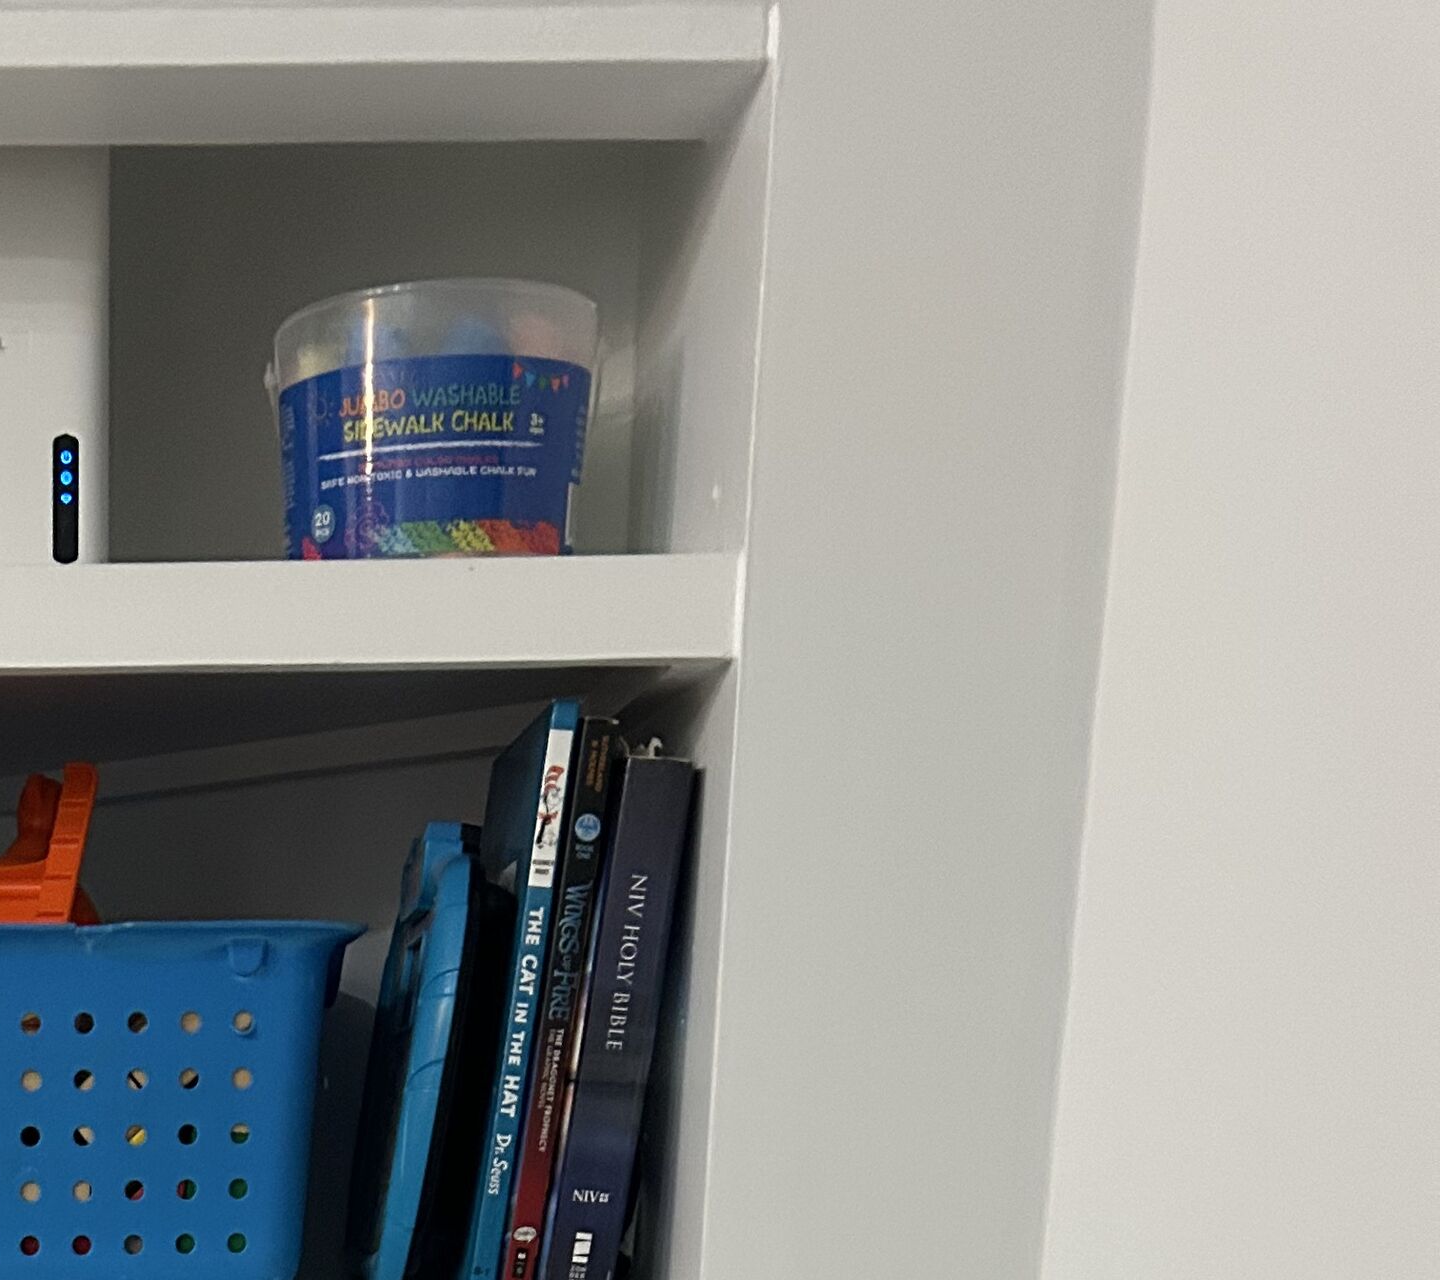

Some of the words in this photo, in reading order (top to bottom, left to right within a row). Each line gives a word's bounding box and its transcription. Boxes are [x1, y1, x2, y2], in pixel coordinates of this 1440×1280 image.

[412, 383, 522, 409] WASHABLE
[343, 412, 445, 443] SIDEWALK
[451, 410, 514, 433] CHALK
[415, 465, 477, 478] WASHABLE
[479, 465, 514, 476] CHALK
[315, 511, 330, 527] 20
[627, 875, 648, 918] NIV
[525, 907, 544, 945] THE
[559, 882, 591, 953] WINGS
[616, 924, 641, 985] HOLY
[519, 955, 538, 995] CAT
[548, 969, 580, 1020] FIRE
[515, 1003, 529, 1024] IN
[605, 992, 631, 1051] BIBLE
[508, 1031, 526, 1066] THE
[554, 1028, 564, 1047] THE
[500, 1075, 521, 1118] HAT
[496, 1133, 512, 1155] Dr.
[488, 1157, 509, 1196] Seuss
[572, 1189, 600, 1203] NIV
